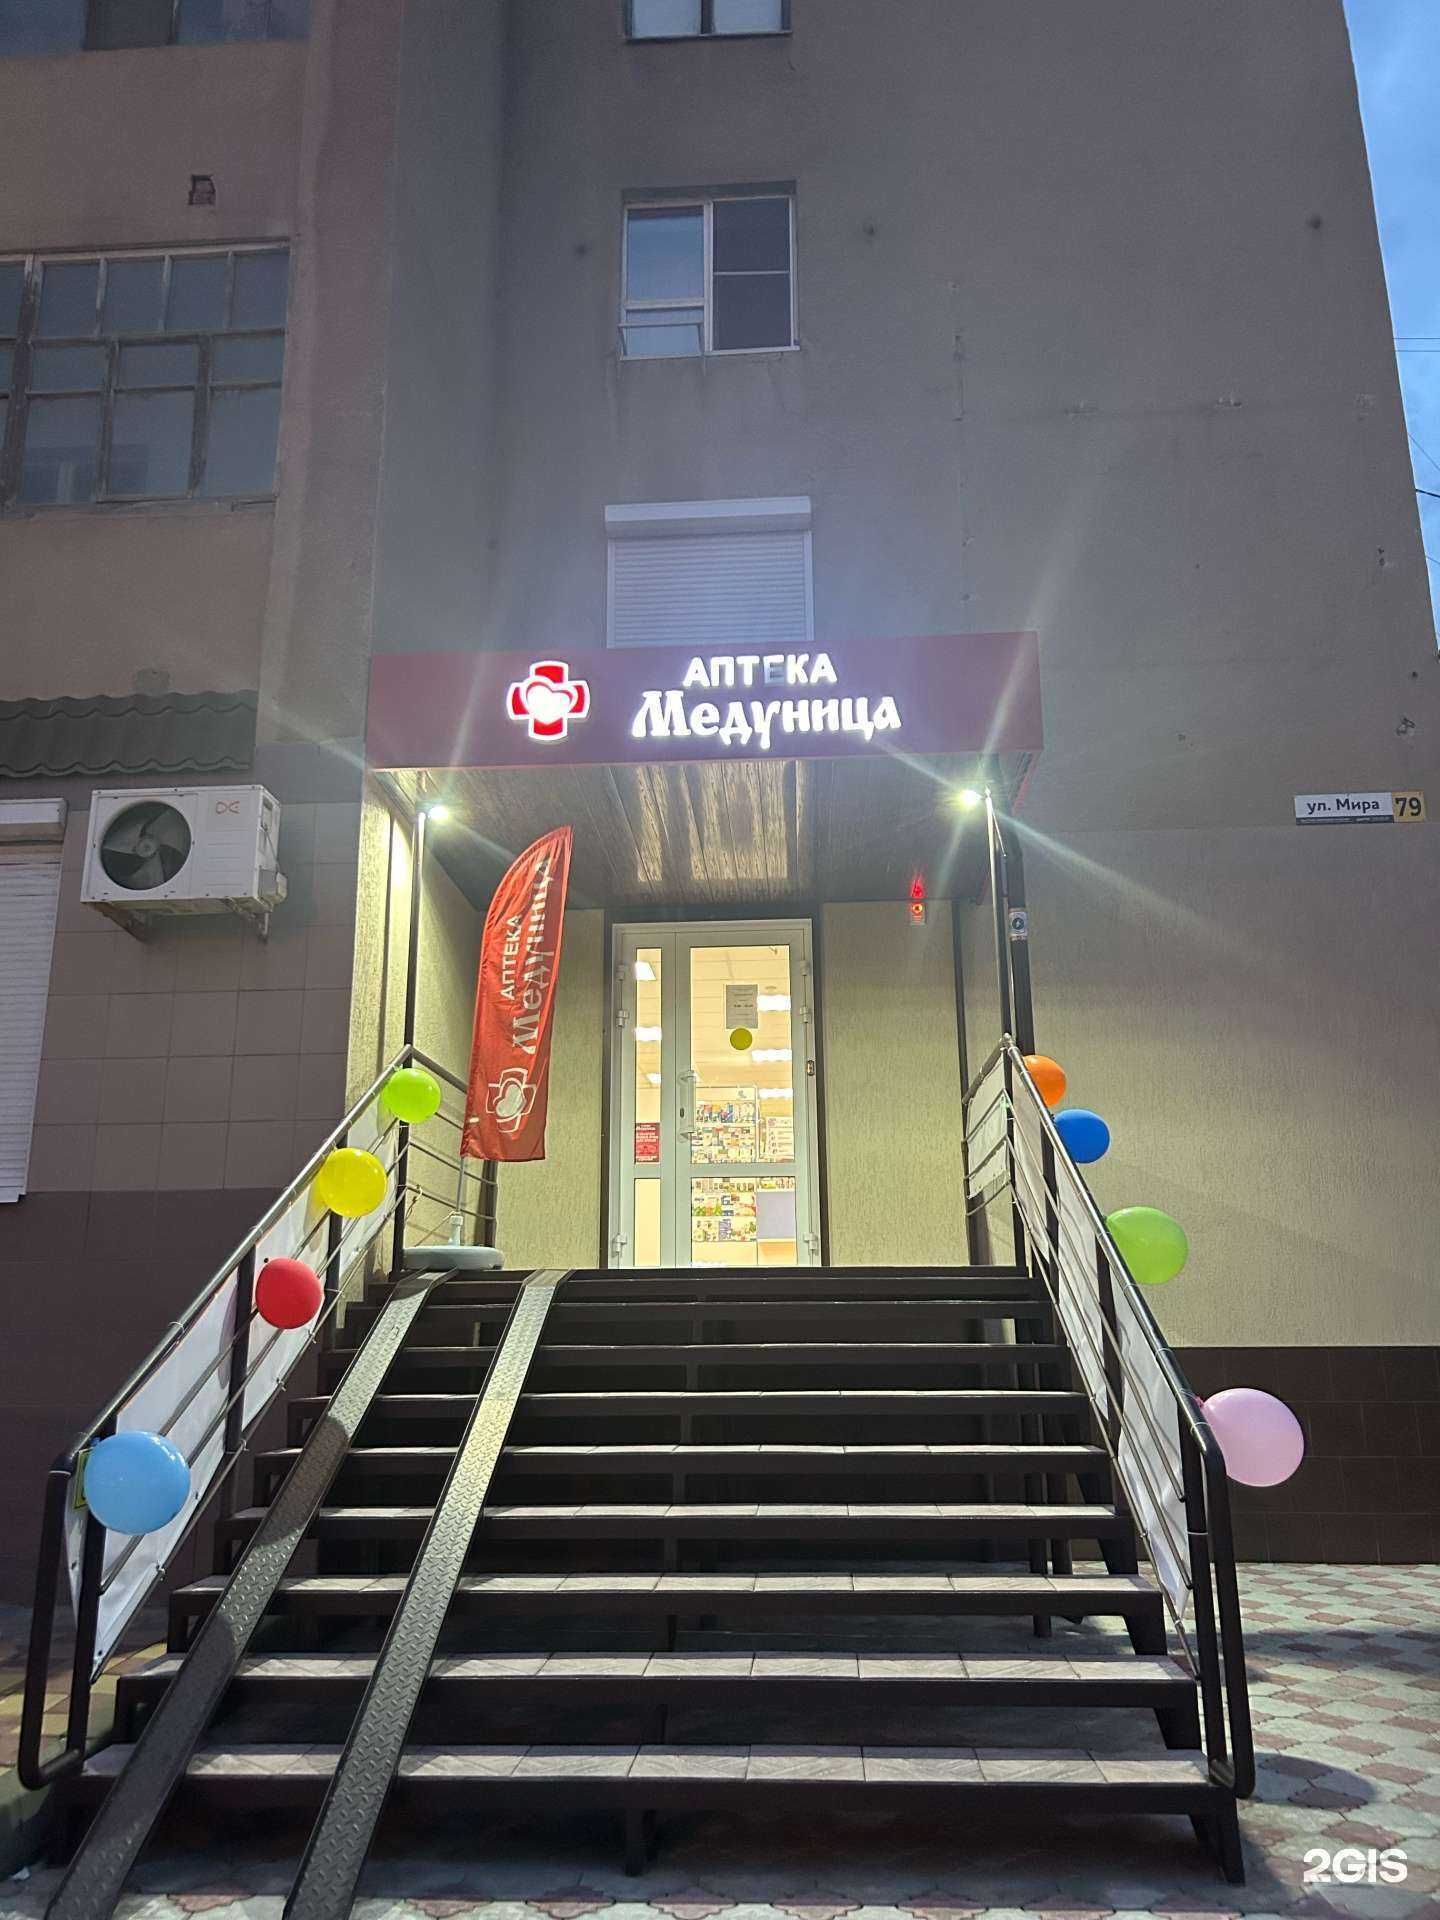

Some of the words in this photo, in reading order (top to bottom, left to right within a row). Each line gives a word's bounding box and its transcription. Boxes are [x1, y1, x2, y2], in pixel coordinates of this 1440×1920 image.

[682, 652, 839, 689] АПТЕКА
[630, 689, 902, 750] Медуница
[1306, 801, 1332, 815] ул.
[1336, 798, 1380, 814] Мира
[1395, 796, 1422, 818] 79
[499, 913, 524, 1001] АПТЕКА
